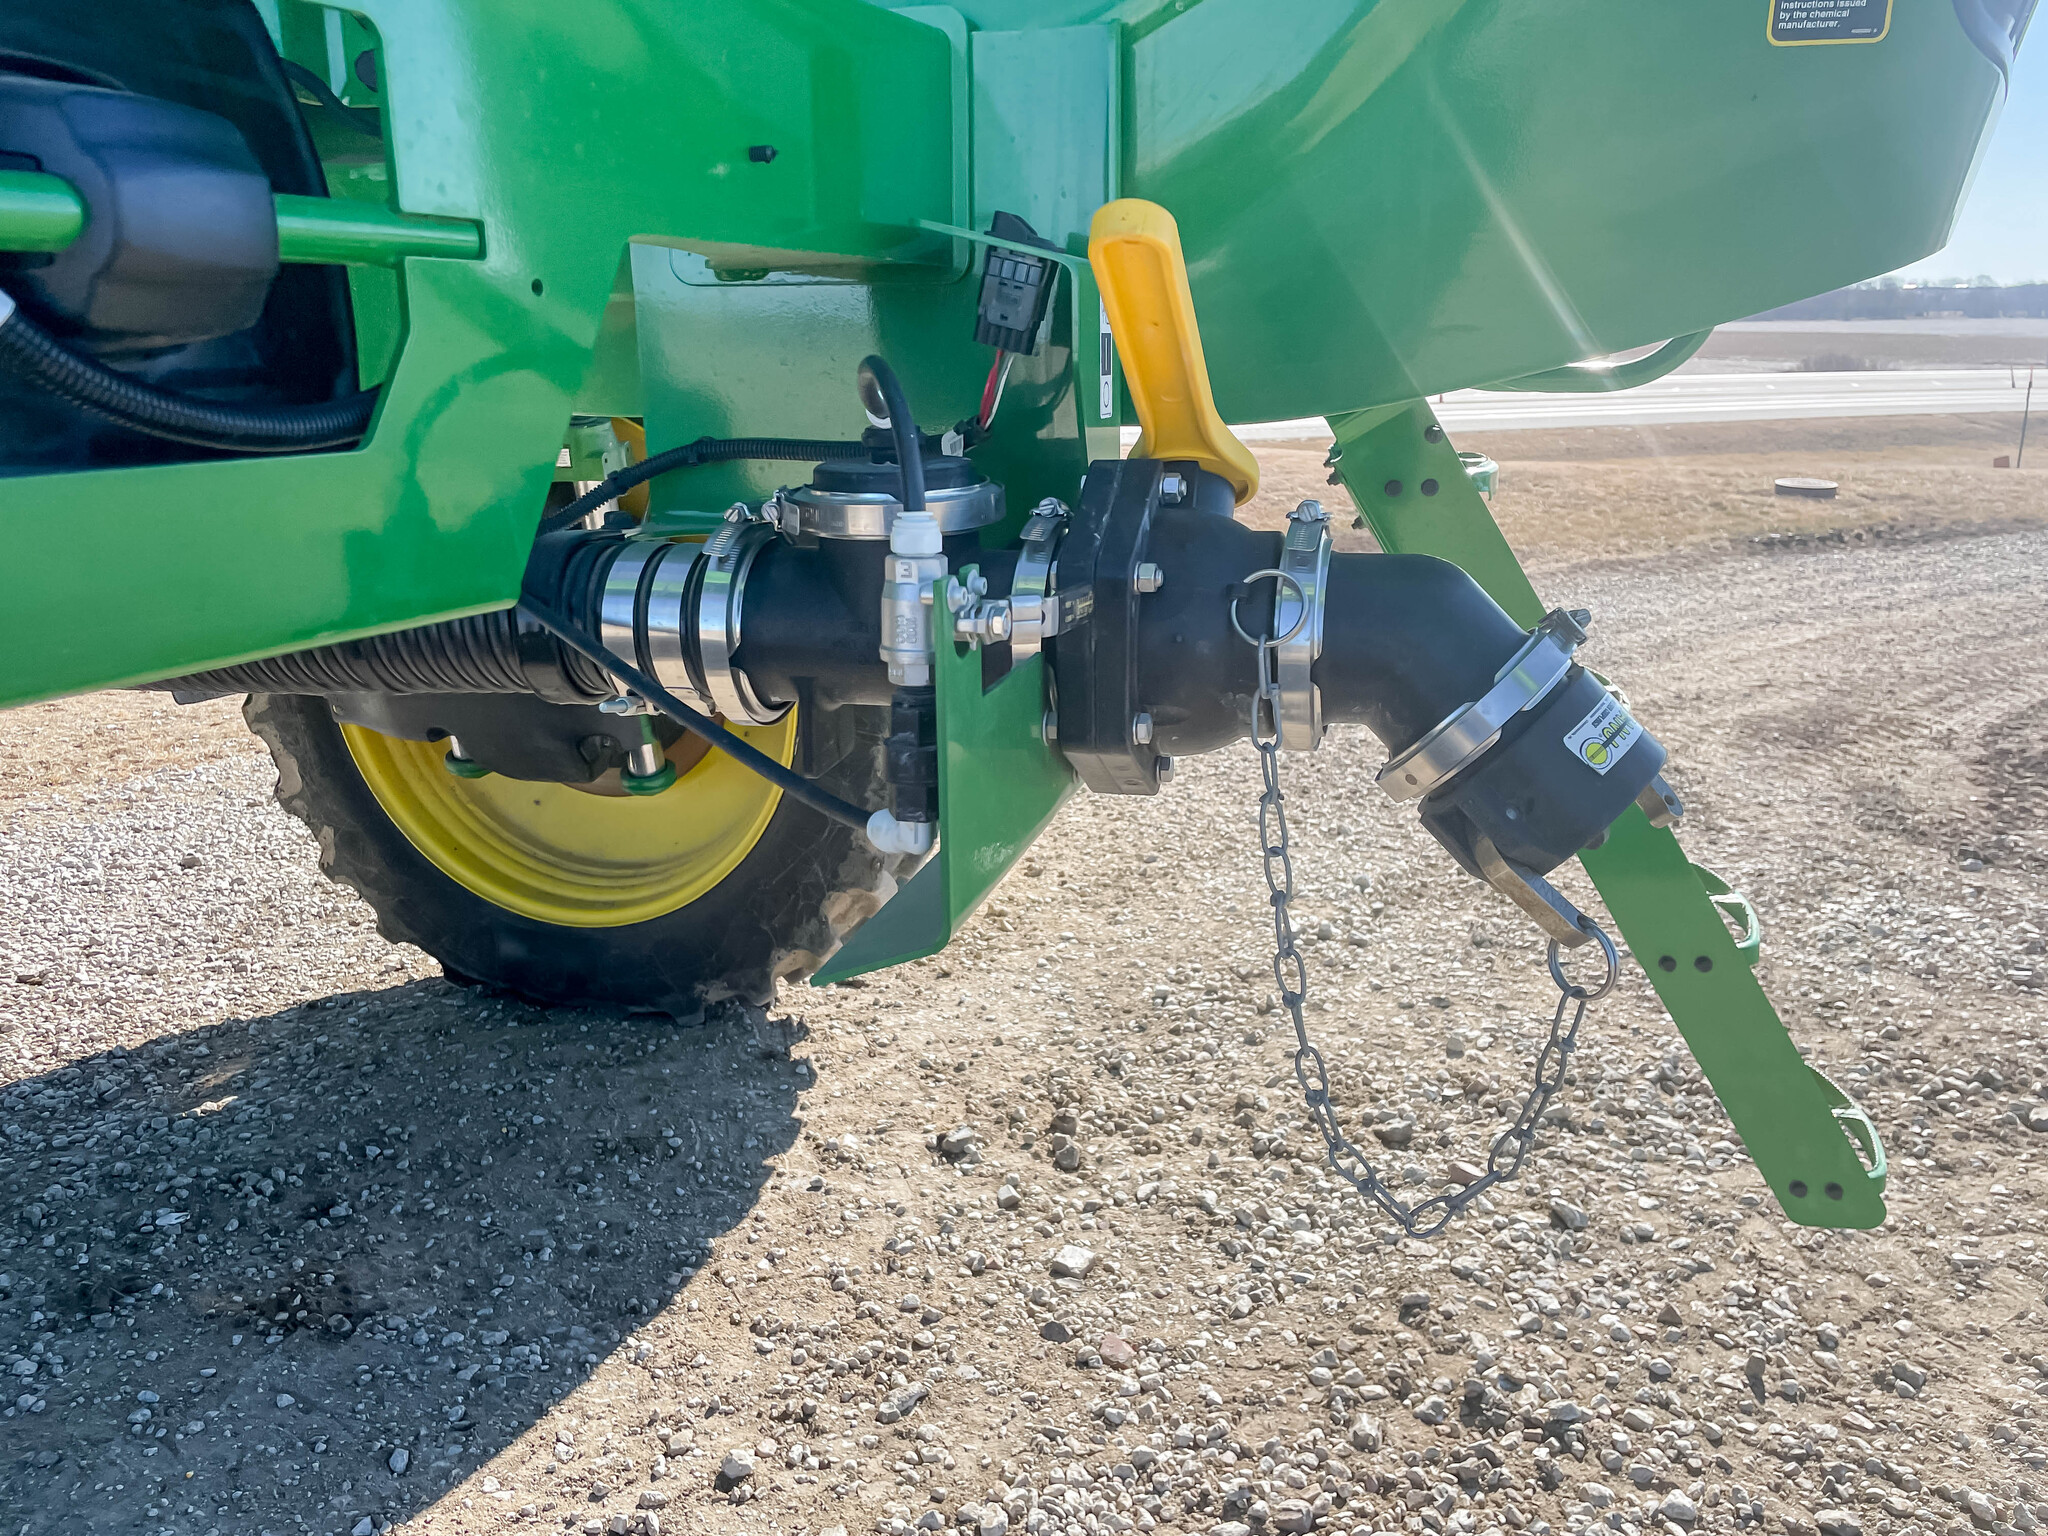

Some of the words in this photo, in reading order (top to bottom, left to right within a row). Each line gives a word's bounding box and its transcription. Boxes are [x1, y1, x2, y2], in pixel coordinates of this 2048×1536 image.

[1780, 0, 1834, 9] instructions
[1780, 11, 1790, 21] by
[1793, 11, 1807, 19] the
[1809, 9, 1850, 18] chemical
[1778, 20, 1840, 29] manufacturer.
